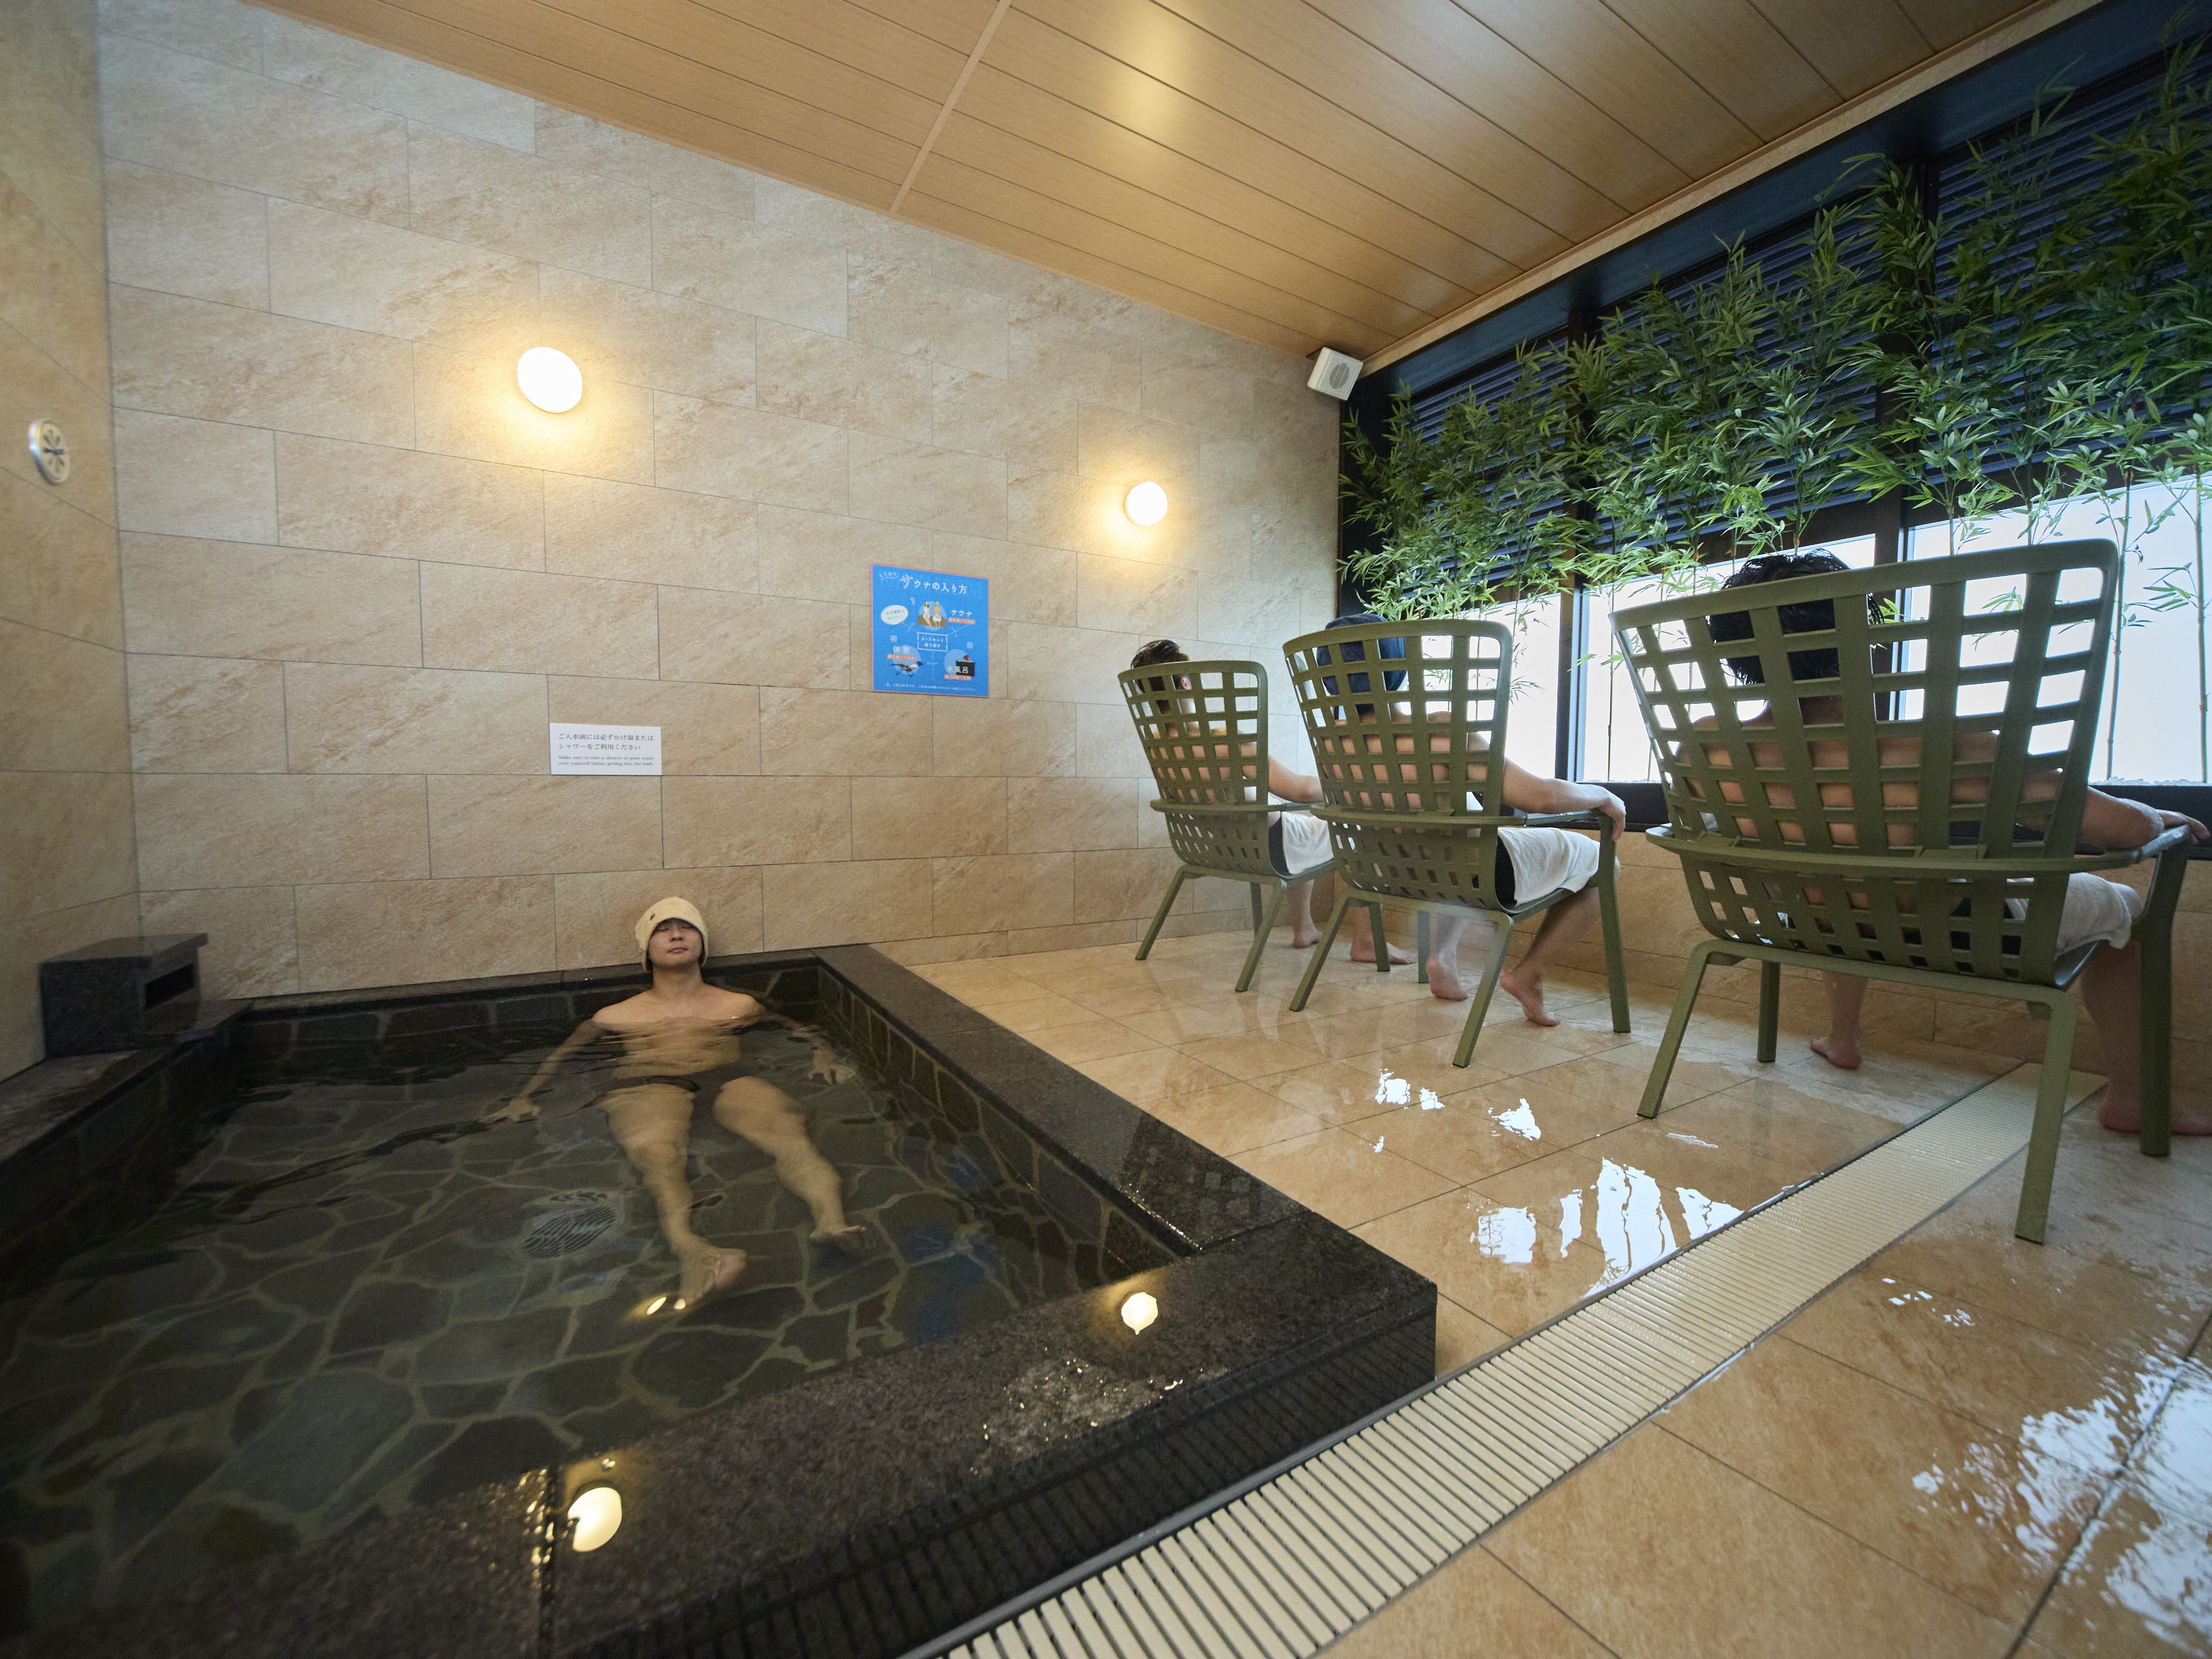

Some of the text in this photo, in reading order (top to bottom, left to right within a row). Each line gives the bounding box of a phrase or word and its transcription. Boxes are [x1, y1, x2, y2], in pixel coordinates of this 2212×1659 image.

[899, 574, 968, 594] サウナの入り方
